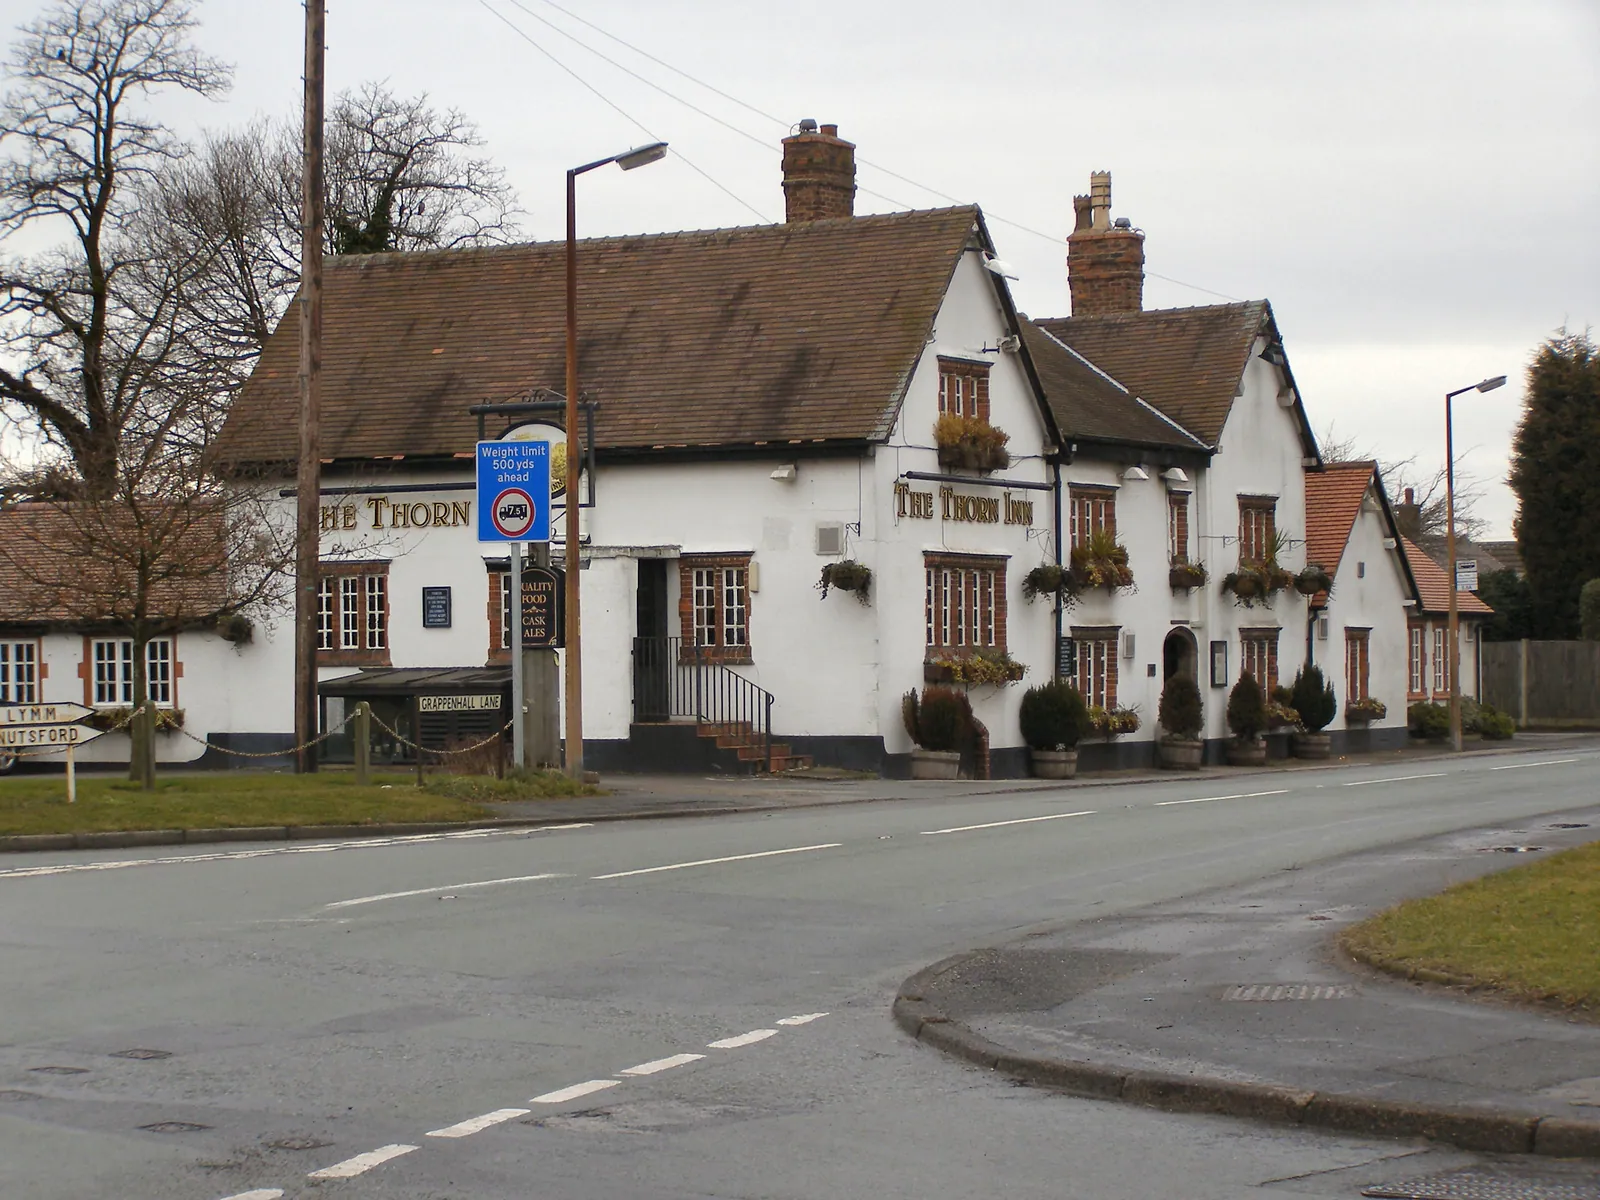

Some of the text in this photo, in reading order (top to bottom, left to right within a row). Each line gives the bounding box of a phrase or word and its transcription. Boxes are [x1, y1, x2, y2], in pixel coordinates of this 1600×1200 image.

[482, 445, 546, 458] Weight limit
[493, 459, 534, 471] 500 yds
[497, 472, 529, 482] ahead
[895, 482, 1033, 525] THE THORN INN
[320, 496, 471, 530] HE THORN
[521, 582, 553, 592] UALITY
[522, 594, 547, 604] FOOD
[522, 616, 546, 626] CASK
[523, 628, 546, 638] ALES
[421, 696, 500, 710] GRAPPENHALL LANE
[7, 707, 57, 722] LYMM
[0, 728, 79, 745] NUTSFORD
